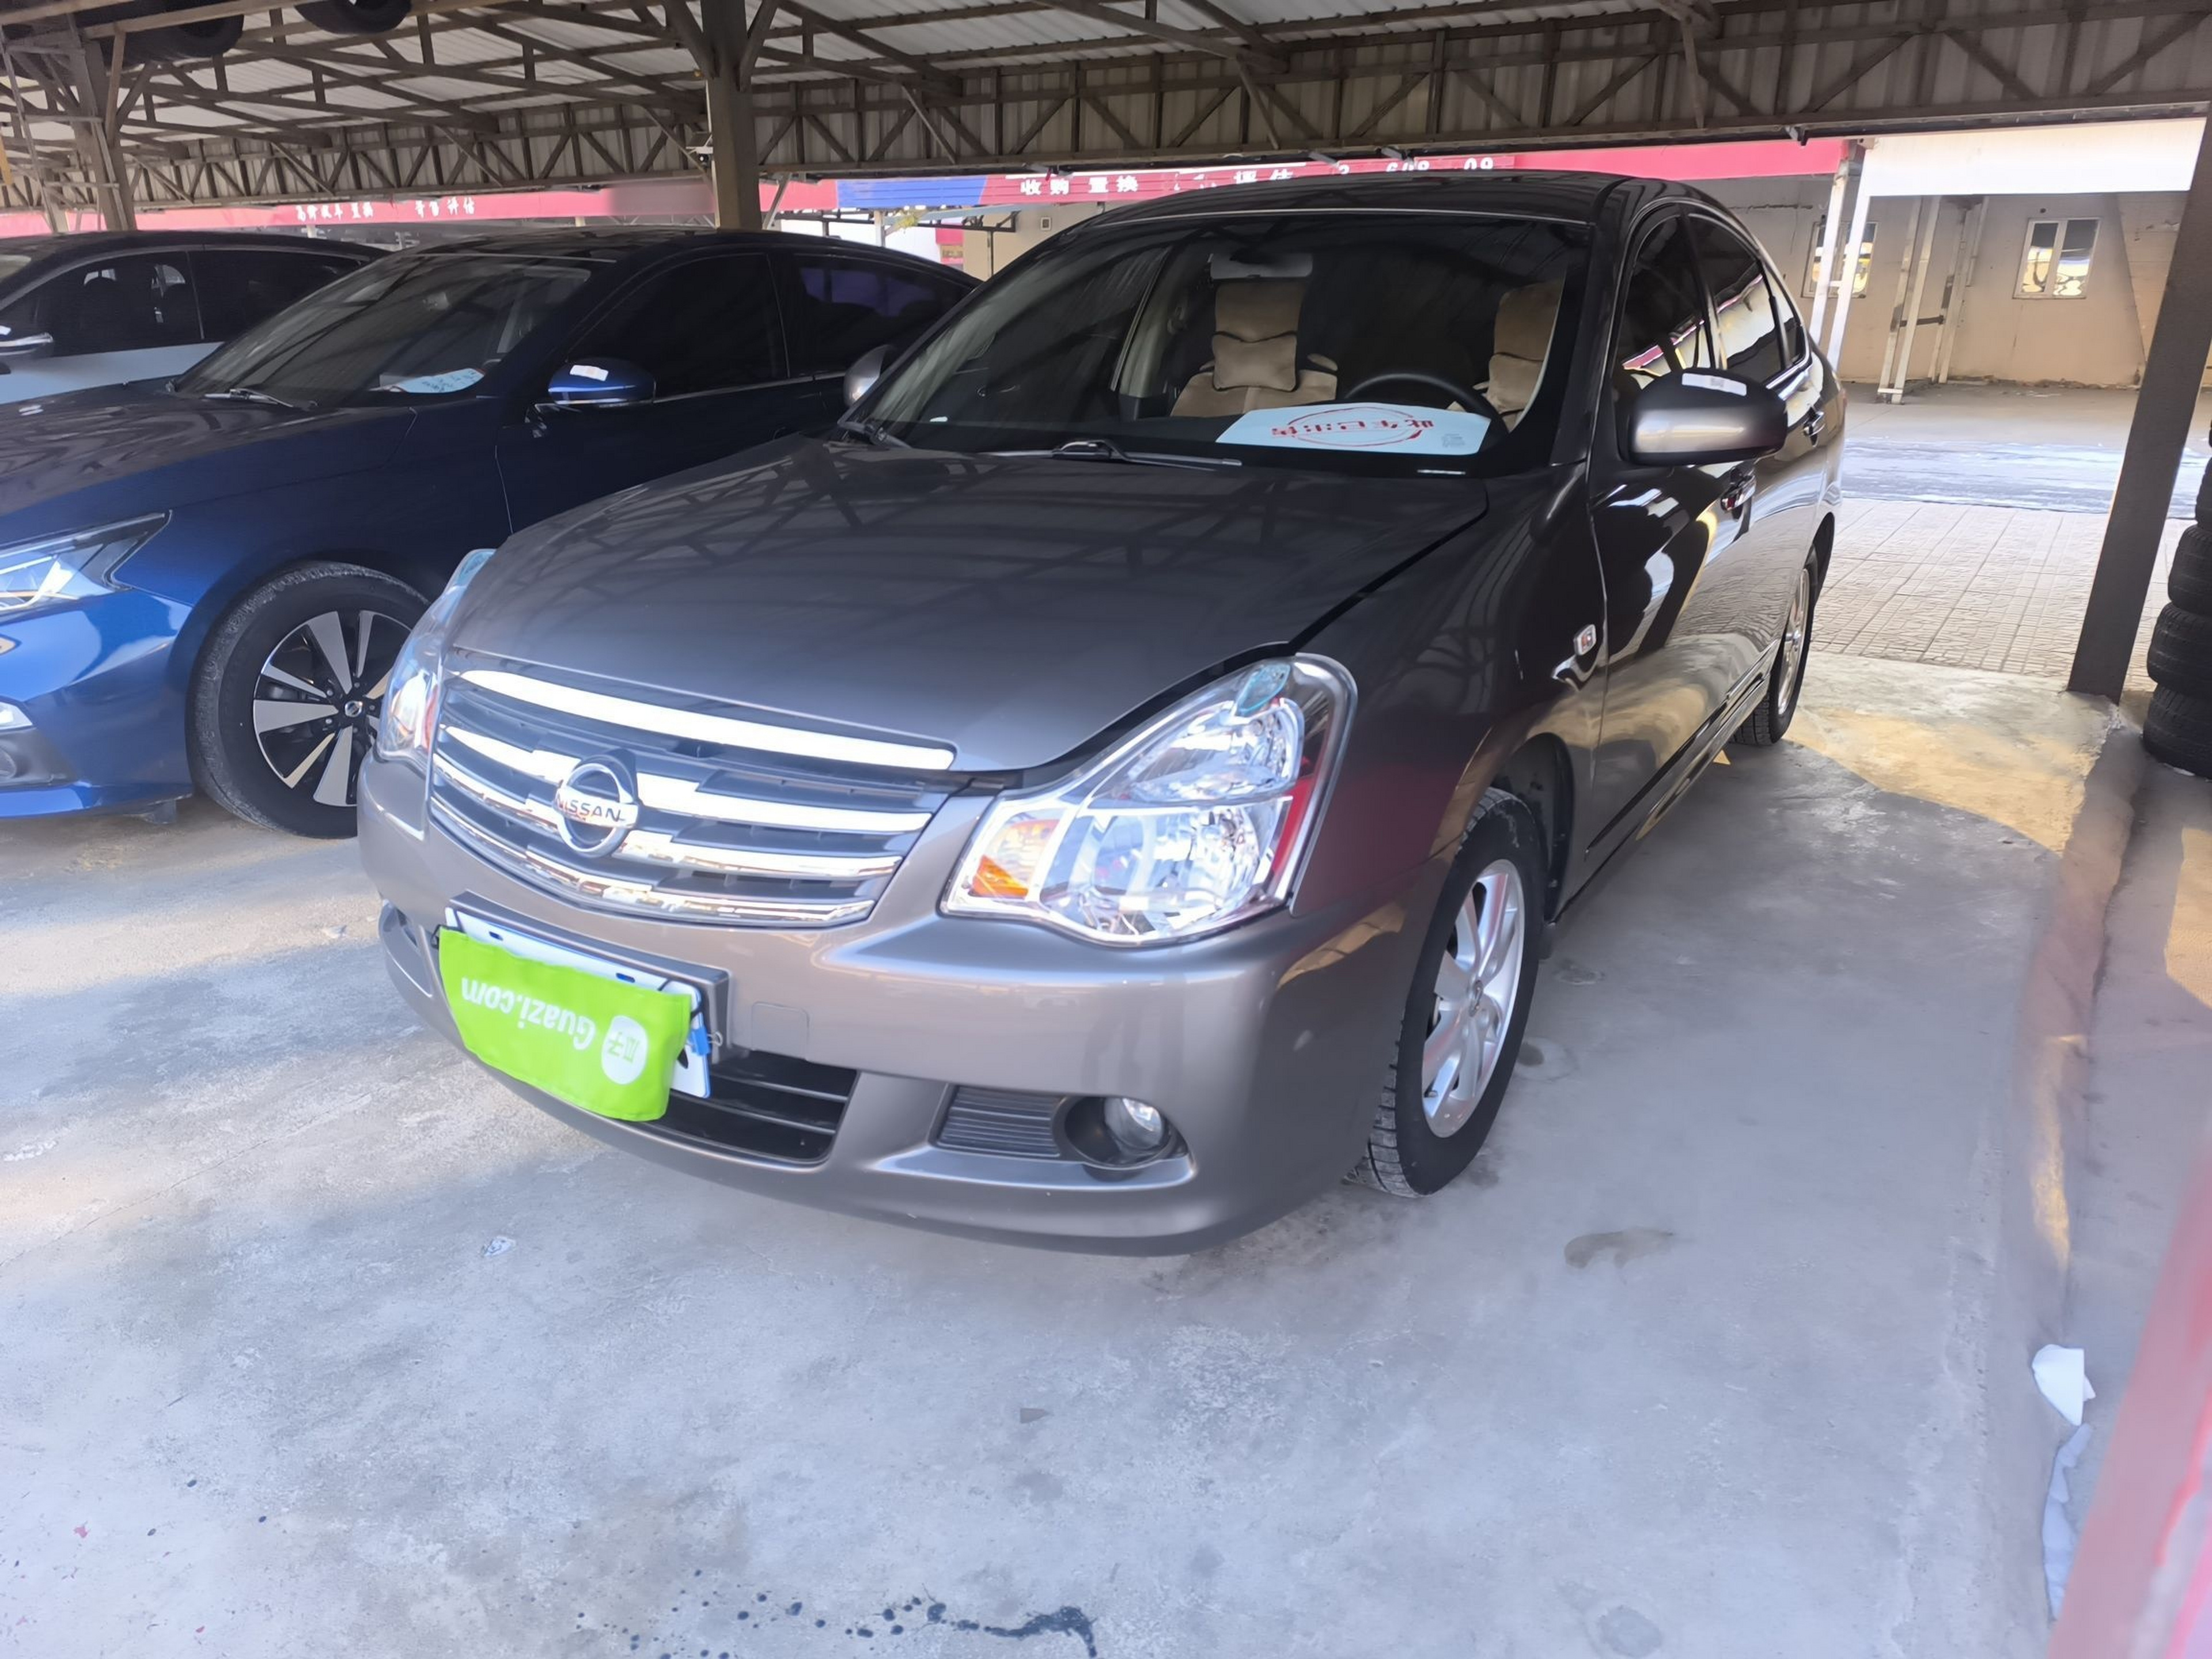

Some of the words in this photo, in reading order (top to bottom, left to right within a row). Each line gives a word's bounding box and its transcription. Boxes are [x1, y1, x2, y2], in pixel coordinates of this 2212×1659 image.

[1020, 178, 1070, 195] 收购
[1088, 175, 1139, 193] 置换
[555, 795, 622, 823] NISSAN
[461, 978, 597, 1051] Guazi.com
[608, 1031, 640, 1063] 瓜子
